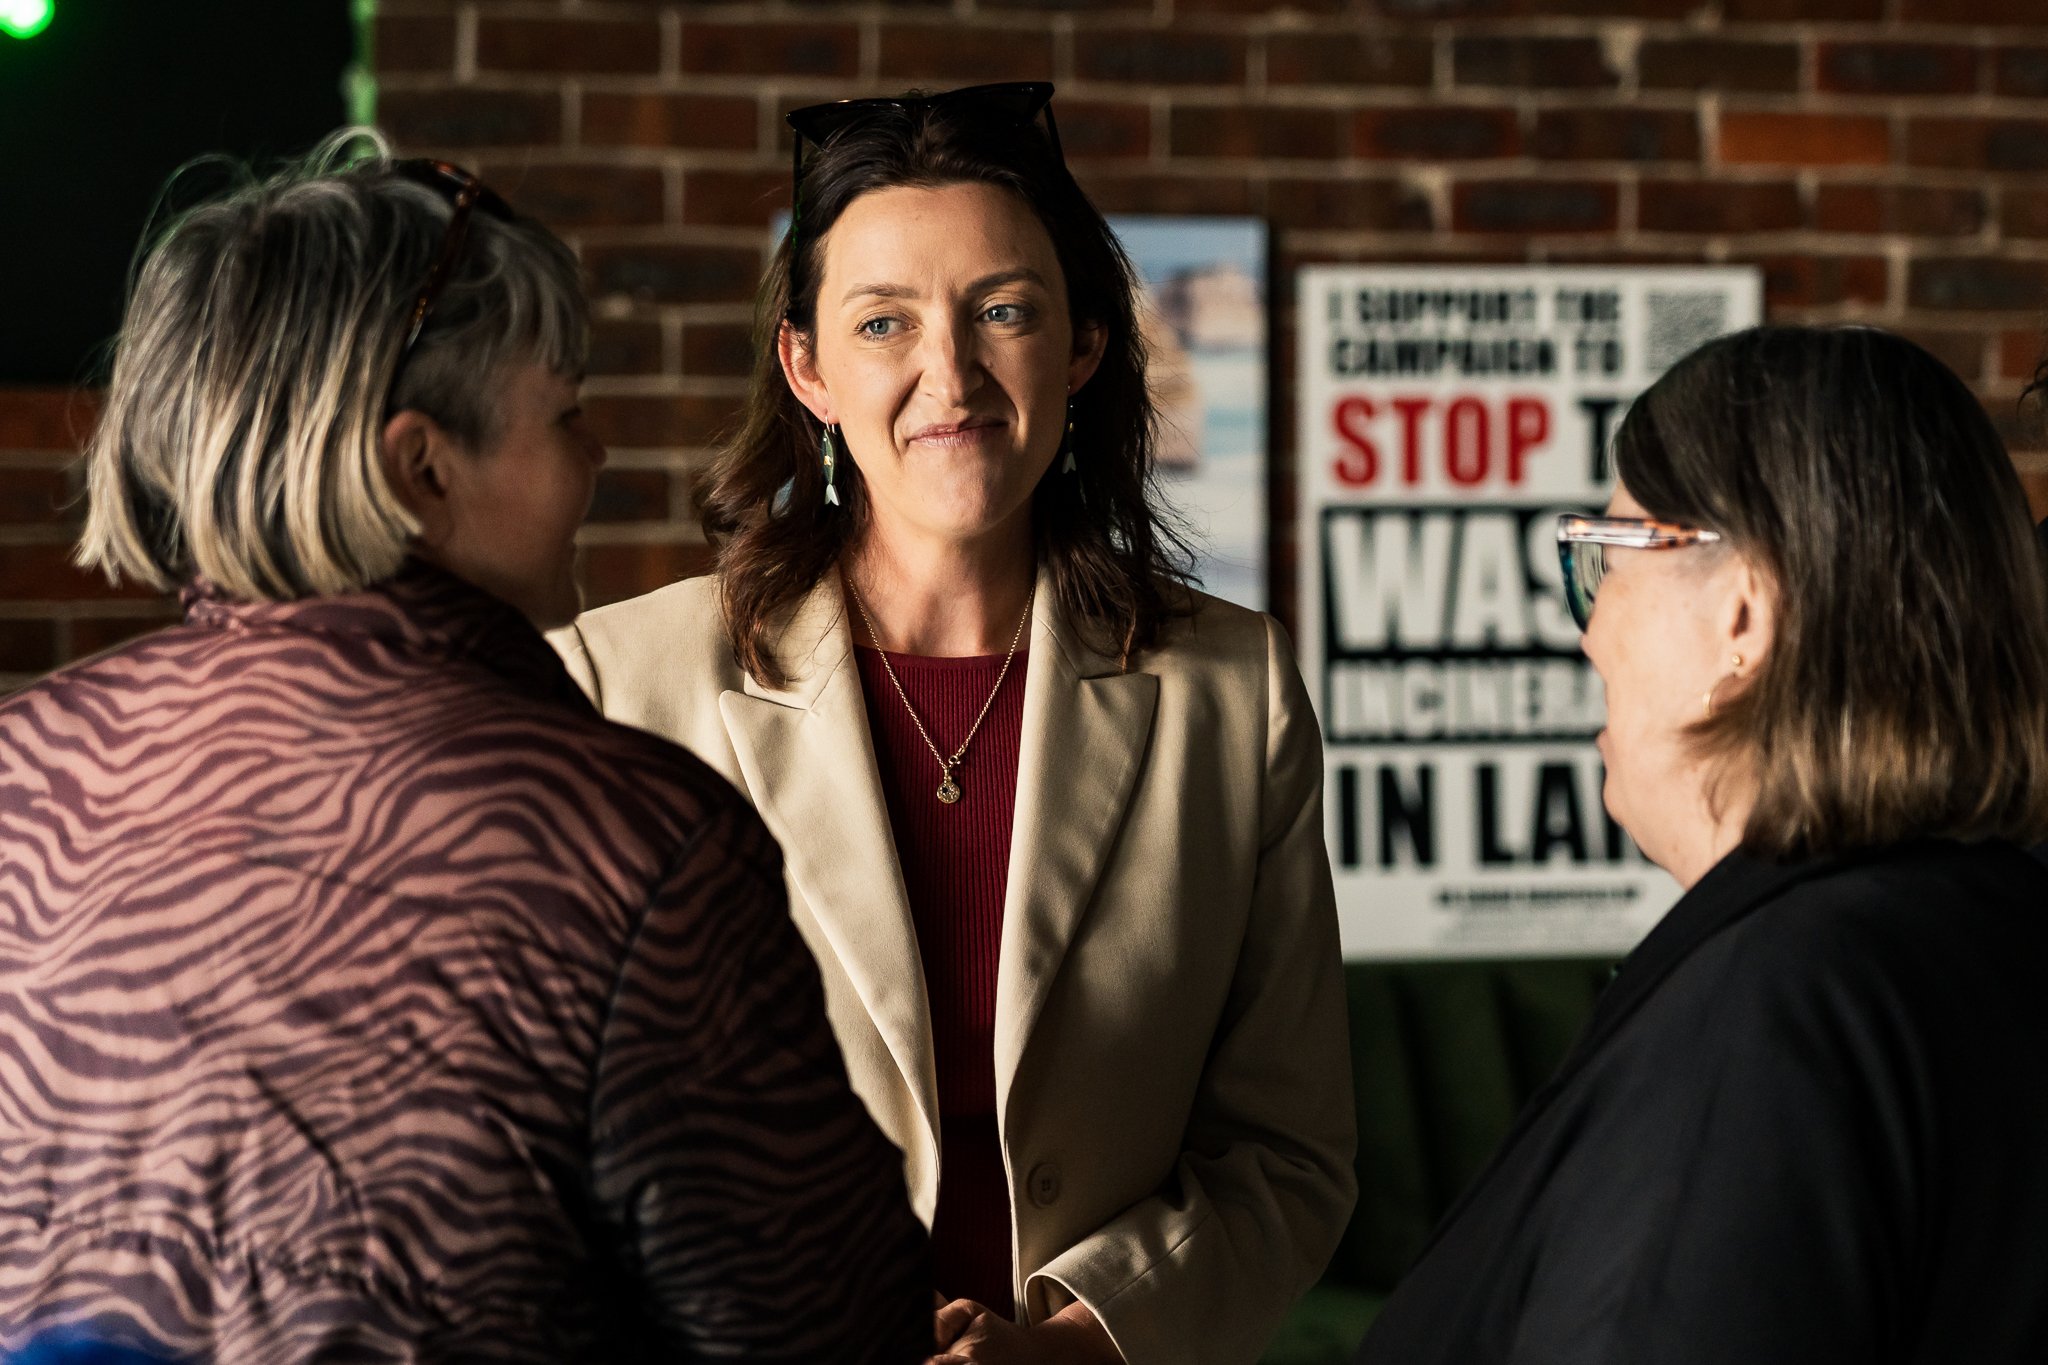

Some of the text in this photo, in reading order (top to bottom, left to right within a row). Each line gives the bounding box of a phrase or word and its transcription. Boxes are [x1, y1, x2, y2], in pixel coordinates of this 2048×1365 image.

[1358, 287, 1537, 321] SUPPORT
[1555, 287, 1621, 321] THE
[1329, 339, 1624, 374] CAMPAIGN TO
[1331, 396, 1622, 486] STOP T
[1337, 764, 1435, 870] IN
